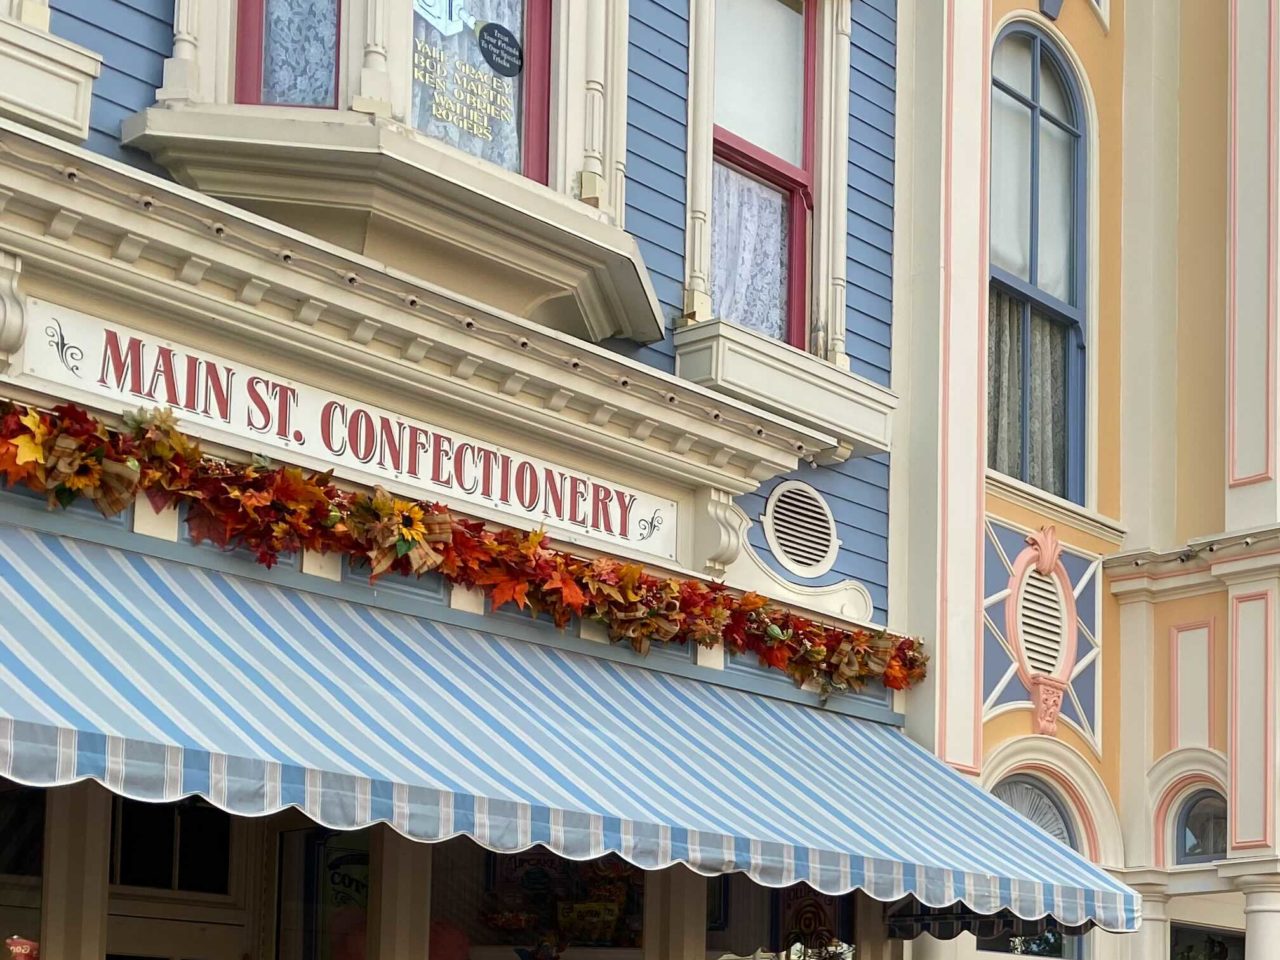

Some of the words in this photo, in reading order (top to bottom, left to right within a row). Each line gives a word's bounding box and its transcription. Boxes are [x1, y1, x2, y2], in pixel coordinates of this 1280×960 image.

[414, 67, 447, 92] KEN
[453, 88, 512, 124] O'BRIEN
[453, 73, 512, 109] MARTIN
[455, 60, 512, 94] GRACEY
[432, 103, 494, 140] ROGERS
[98, 328, 236, 424] MAIN
[245, 375, 306, 444] ST.
[319, 399, 640, 541] CONFECTIONERY
